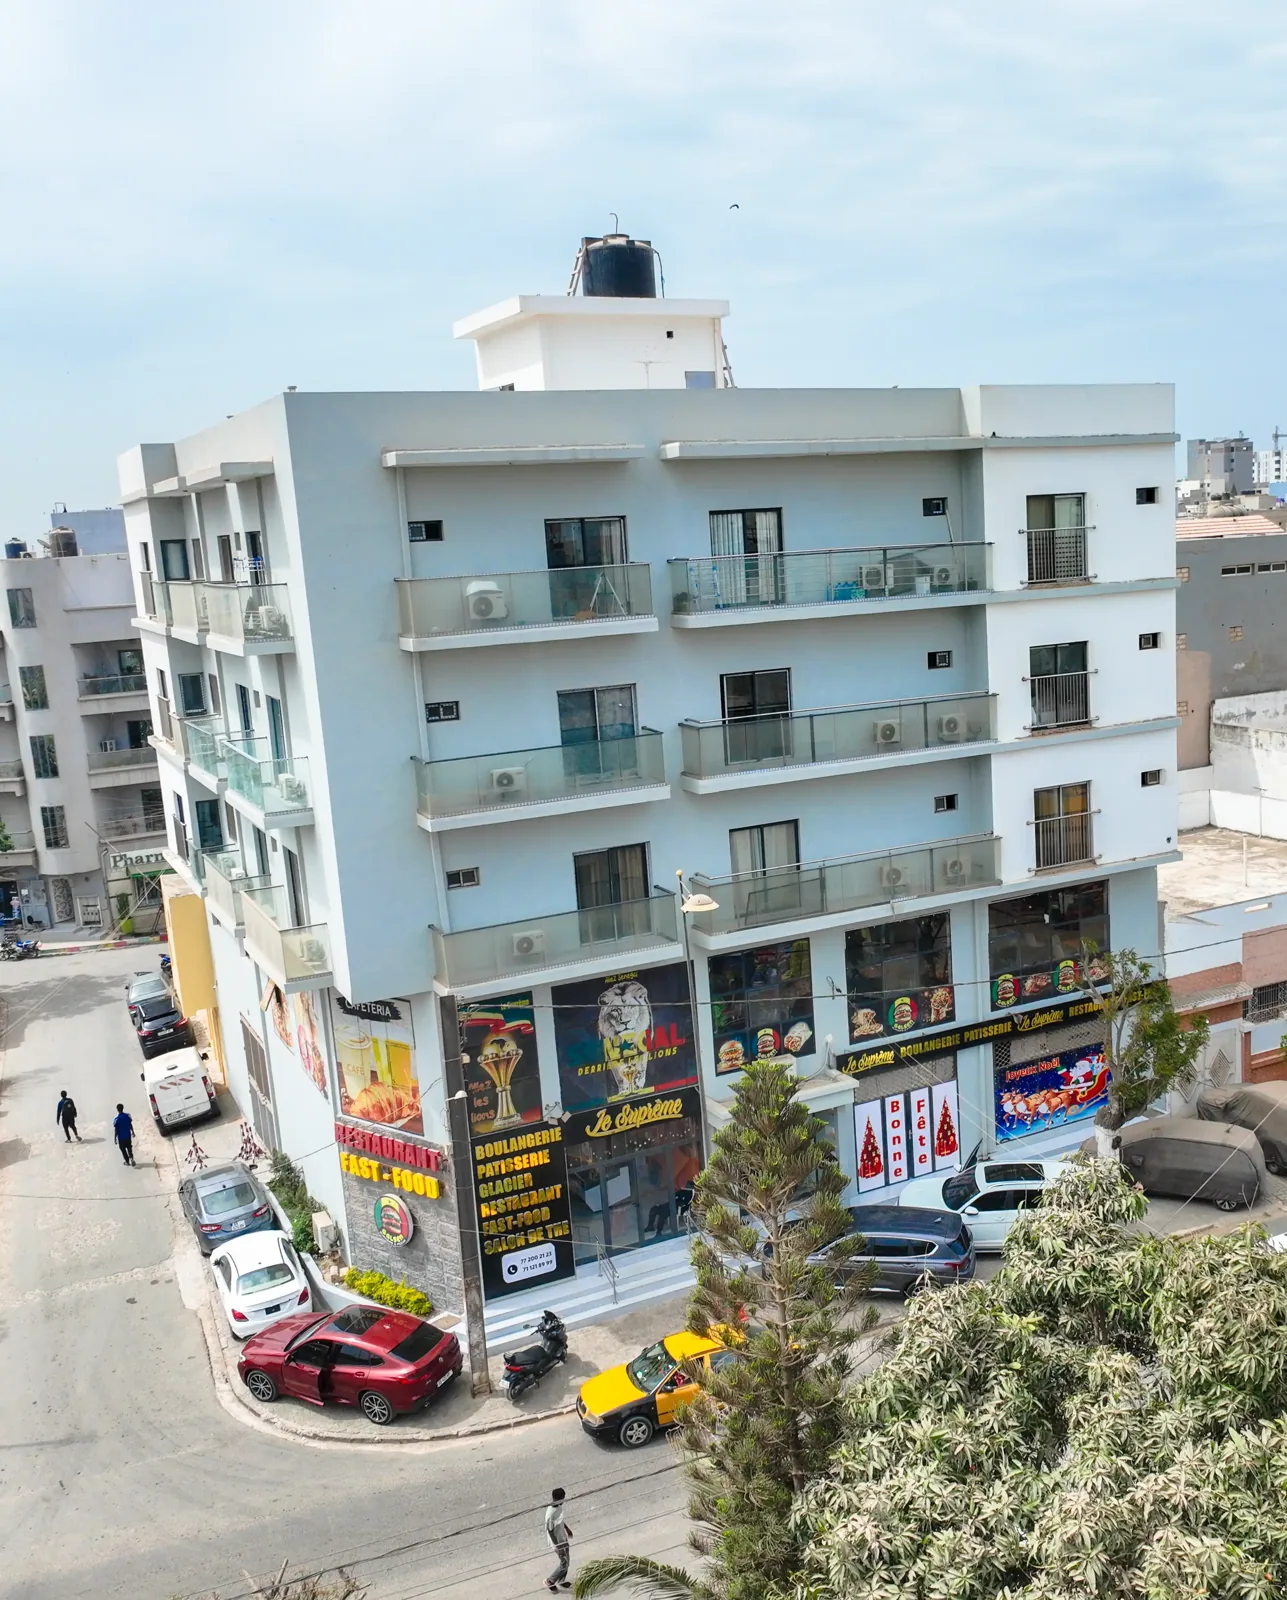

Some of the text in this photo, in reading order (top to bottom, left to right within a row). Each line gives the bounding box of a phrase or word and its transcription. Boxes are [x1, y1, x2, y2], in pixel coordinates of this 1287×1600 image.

[648, 1046, 678, 1061] LIONS
[900, 1032, 961, 1059] BOULANGERIE
[964, 1021, 1013, 1043] PATISSERIE
[1005, 1065, 1037, 1083] Joyeux
[470, 1109, 495, 1123] lions
[473, 1096, 489, 1108] les
[475, 1127, 562, 1160] BOULANGERIE
[890, 1100, 902, 1177] Bonne
[916, 1099, 928, 1164] Fête
[334, 1121, 441, 1173] RESTAURANT
[339, 1151, 380, 1182] FAST
[391, 1166, 440, 1199] FOOD
[477, 1149, 550, 1179] PATISSERIE
[479, 1173, 533, 1198] GLACIER
[481, 1184, 562, 1218] RESTAURANT
[482, 1207, 550, 1236] FAST-FOOD
[484, 1232, 525, 1255] SALON
